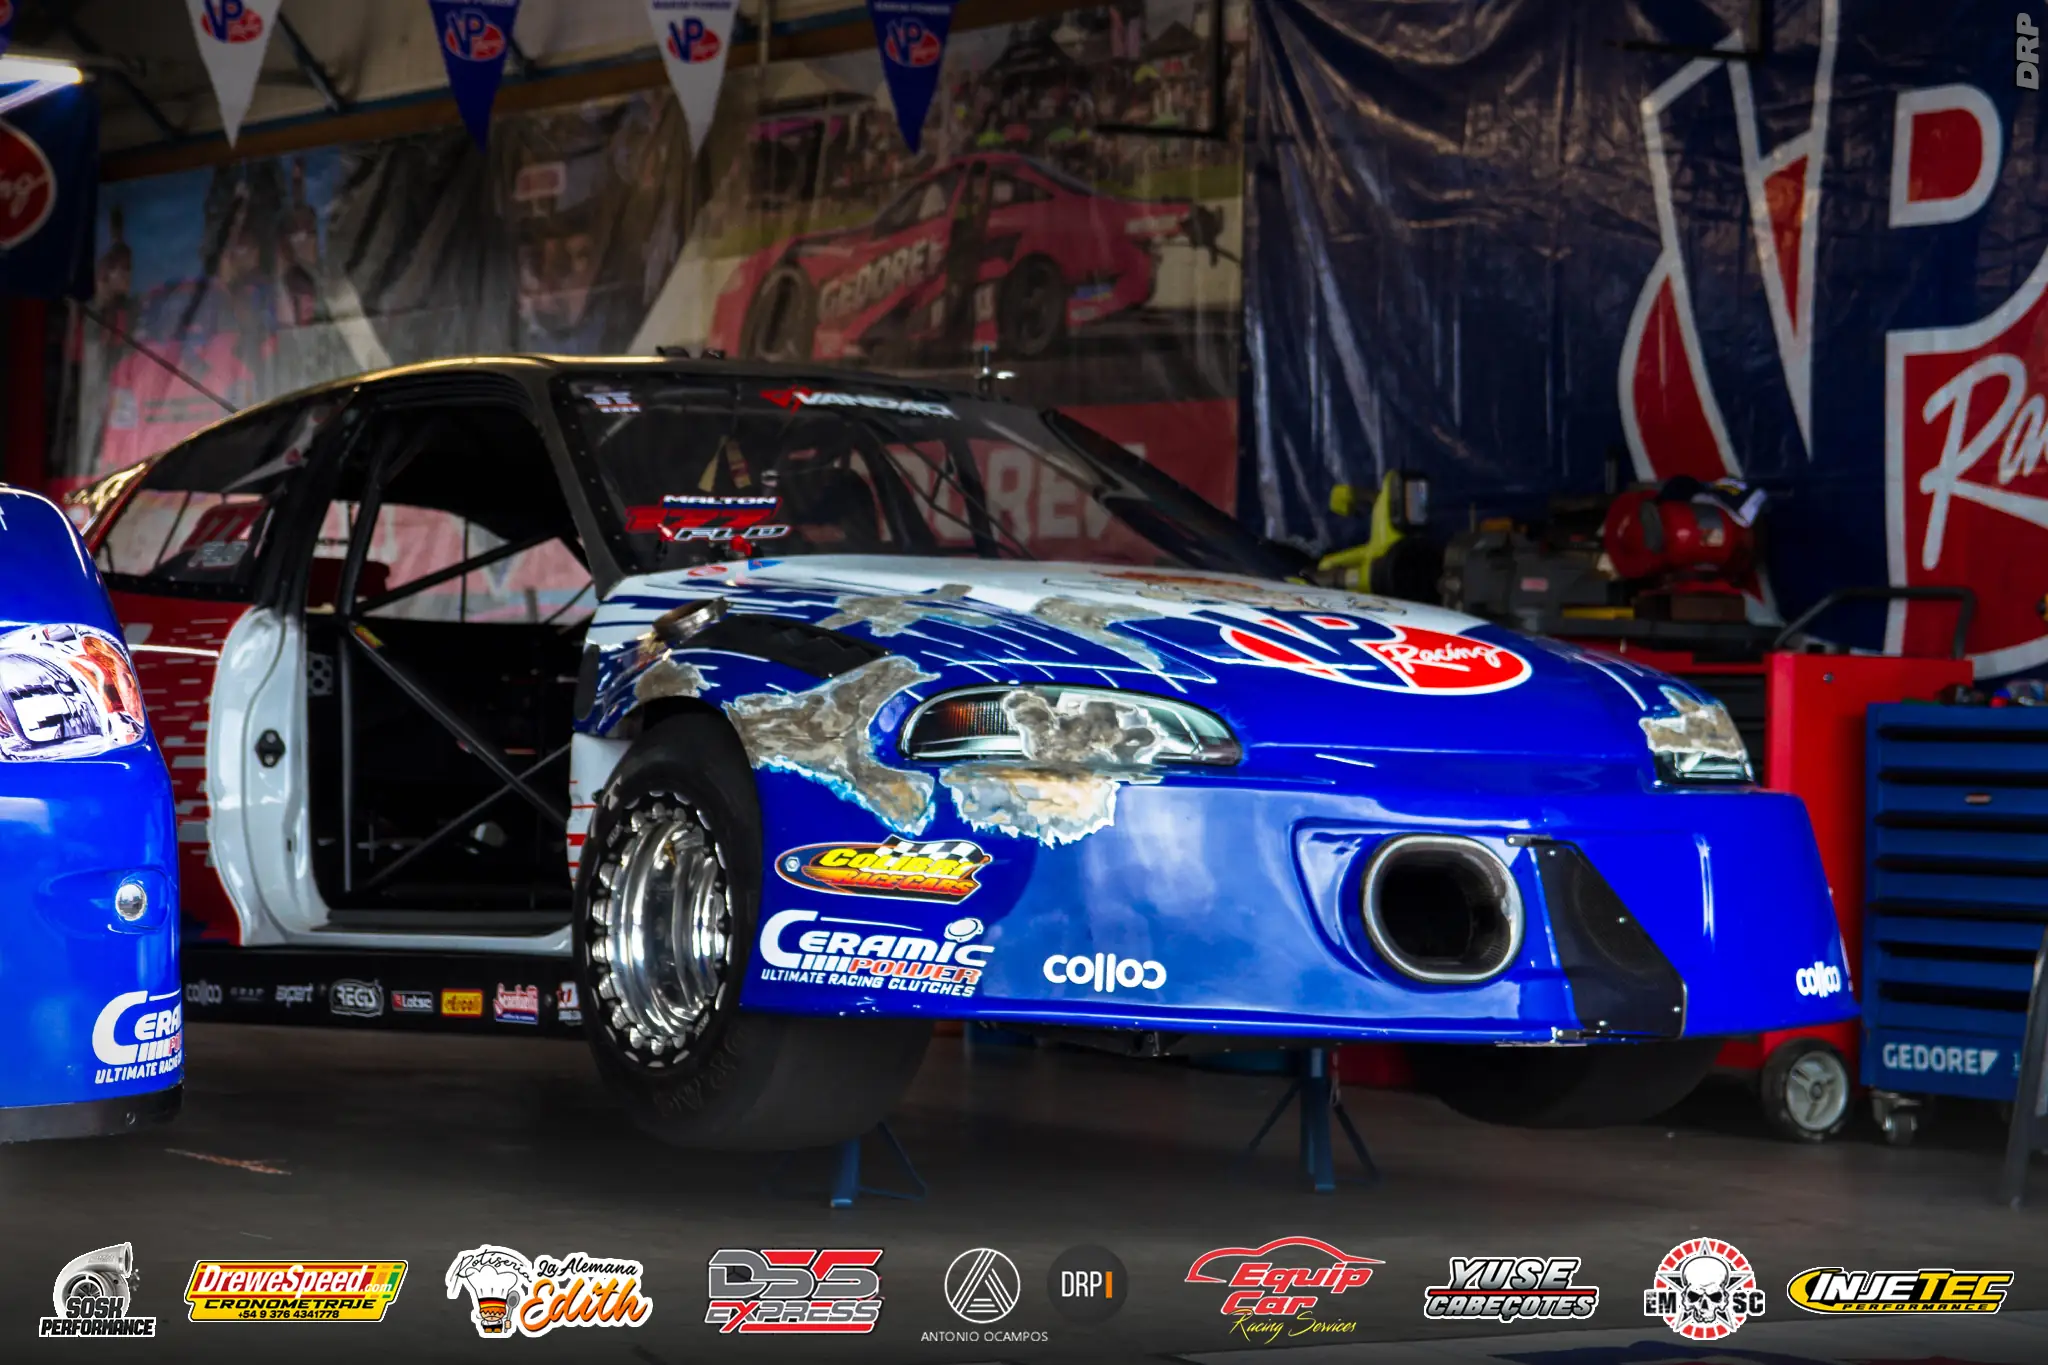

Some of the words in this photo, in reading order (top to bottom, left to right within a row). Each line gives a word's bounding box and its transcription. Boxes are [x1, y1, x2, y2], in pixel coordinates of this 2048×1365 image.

[448, 9, 487, 55] VP
[669, 18, 704, 63] VP
[888, 17, 924, 64] VP
[1377, 641, 1503, 674] Racing
[819, 848, 977, 877] COLIBRI
[760, 909, 996, 969] CERAMIC
[761, 969, 825, 984] ULTIMATE
[828, 973, 884, 989] RACING
[888, 977, 976, 998] CLUTCHES
[848, 958, 984, 985] POWER
[95, 1062, 157, 1084] ULTIMATE
[1883, 1043, 1979, 1075] GEDORE
